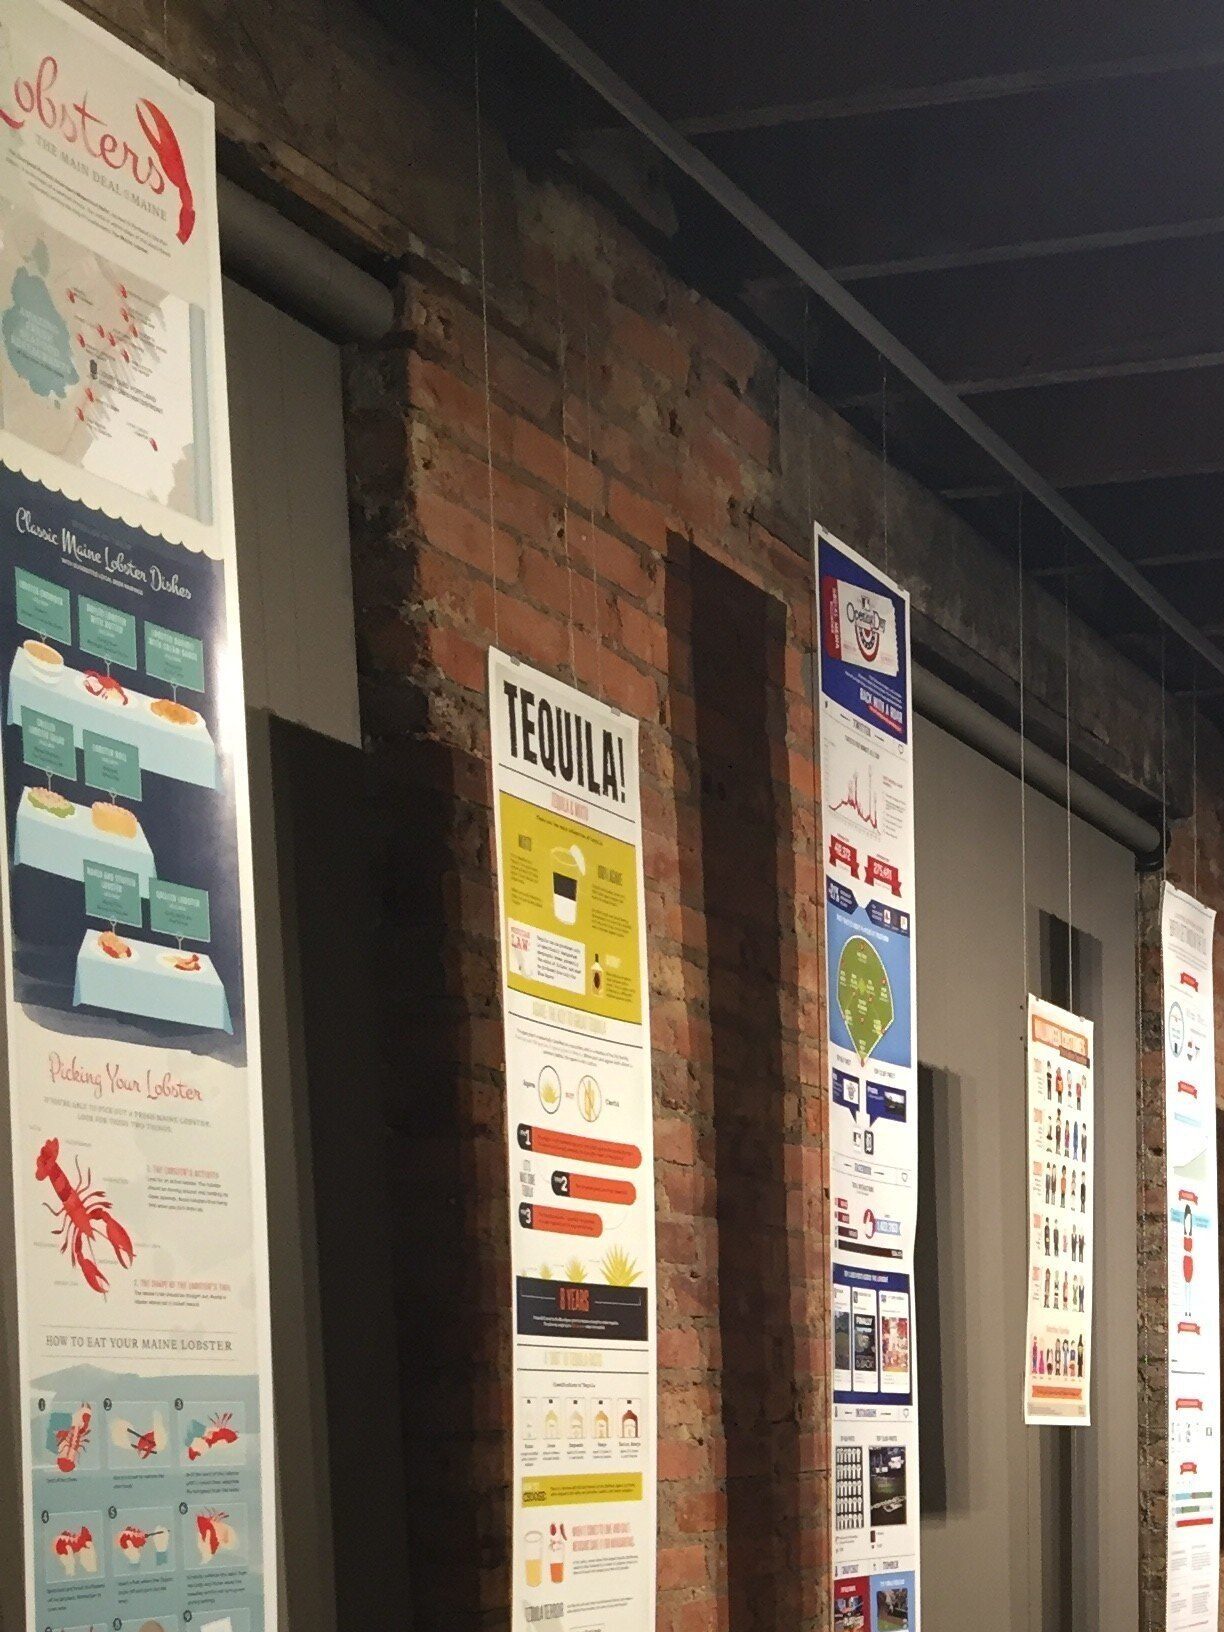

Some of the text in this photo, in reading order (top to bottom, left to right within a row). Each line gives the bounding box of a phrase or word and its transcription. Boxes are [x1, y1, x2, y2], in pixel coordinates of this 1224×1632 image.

[0, 56, 165, 195] obsters
[92, 170, 122, 196] DEAL
[15, 507, 59, 546] Classic
[62, 528, 102, 562] Maine
[105, 547, 147, 582] Lobster
[150, 565, 192, 599] Dishes
[503, 680, 626, 804] TEQUILA!
[49, 1052, 203, 1101] Picking Your Lobster
[46, 1335, 232, 1352] HOW TO EAT YOUR MAINE LOBSTER
